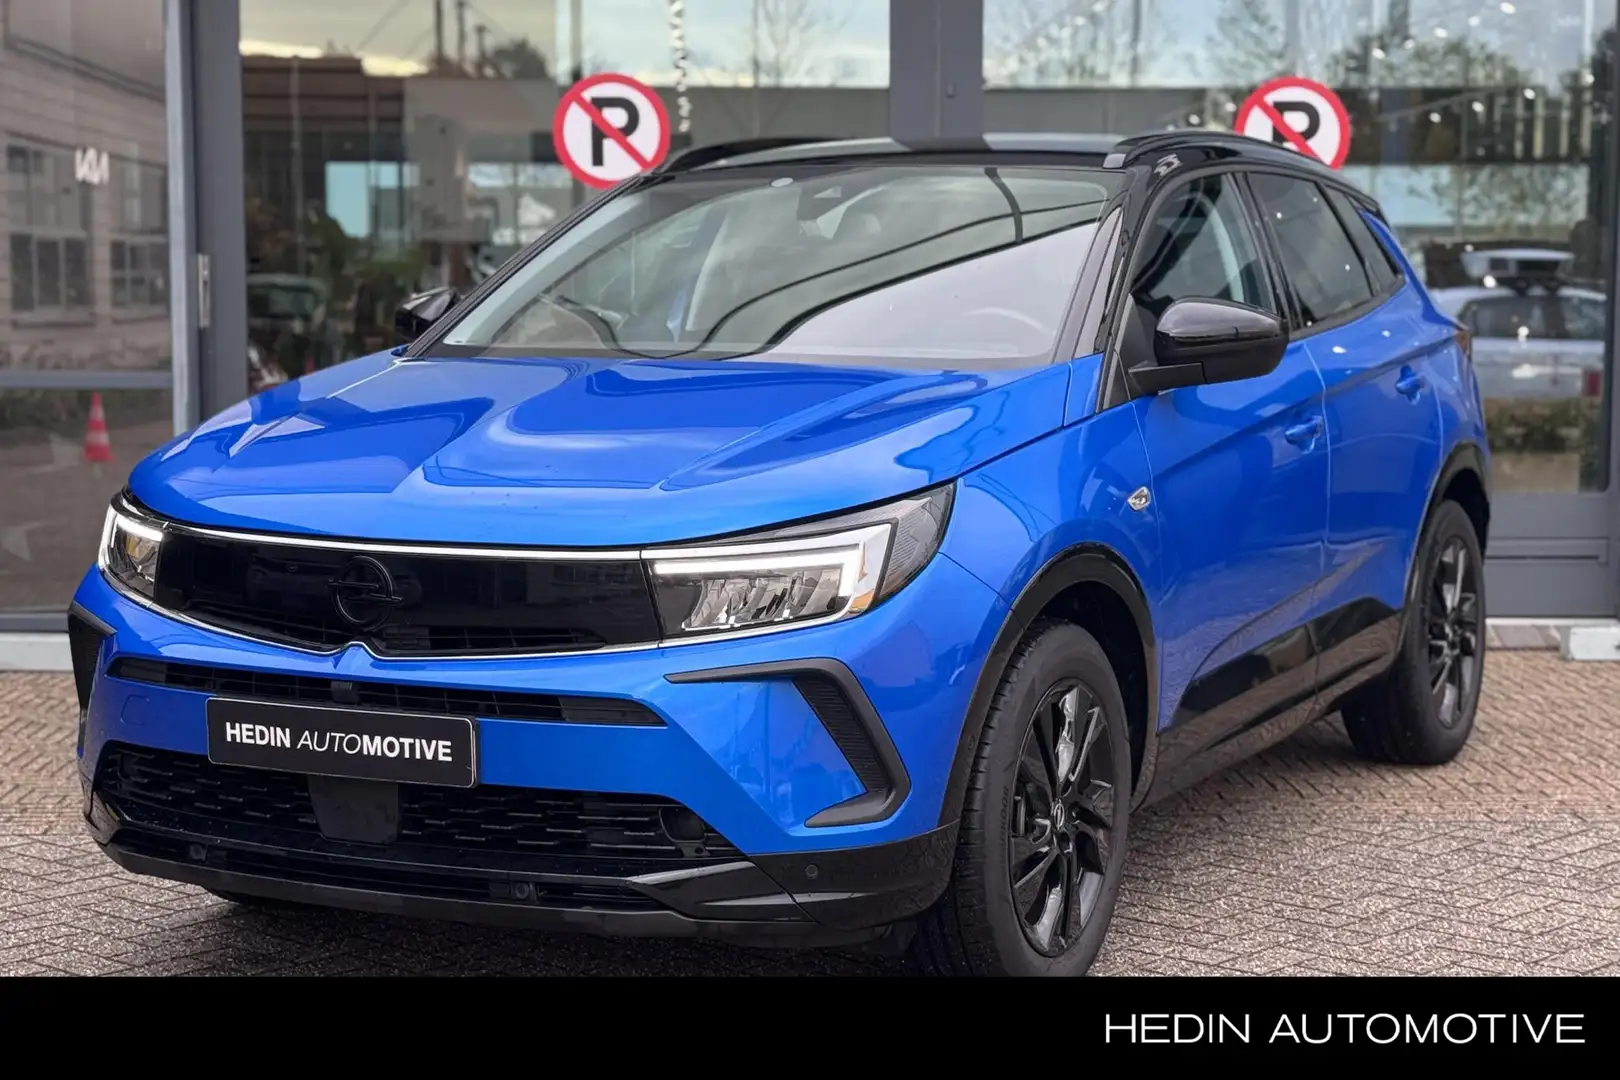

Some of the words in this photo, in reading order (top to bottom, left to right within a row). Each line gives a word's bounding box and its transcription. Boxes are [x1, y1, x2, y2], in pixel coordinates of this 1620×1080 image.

[591, 97, 639, 166] P
[225, 721, 291, 748] HEDIN
[297, 730, 453, 762] AUTOMOTIVE
